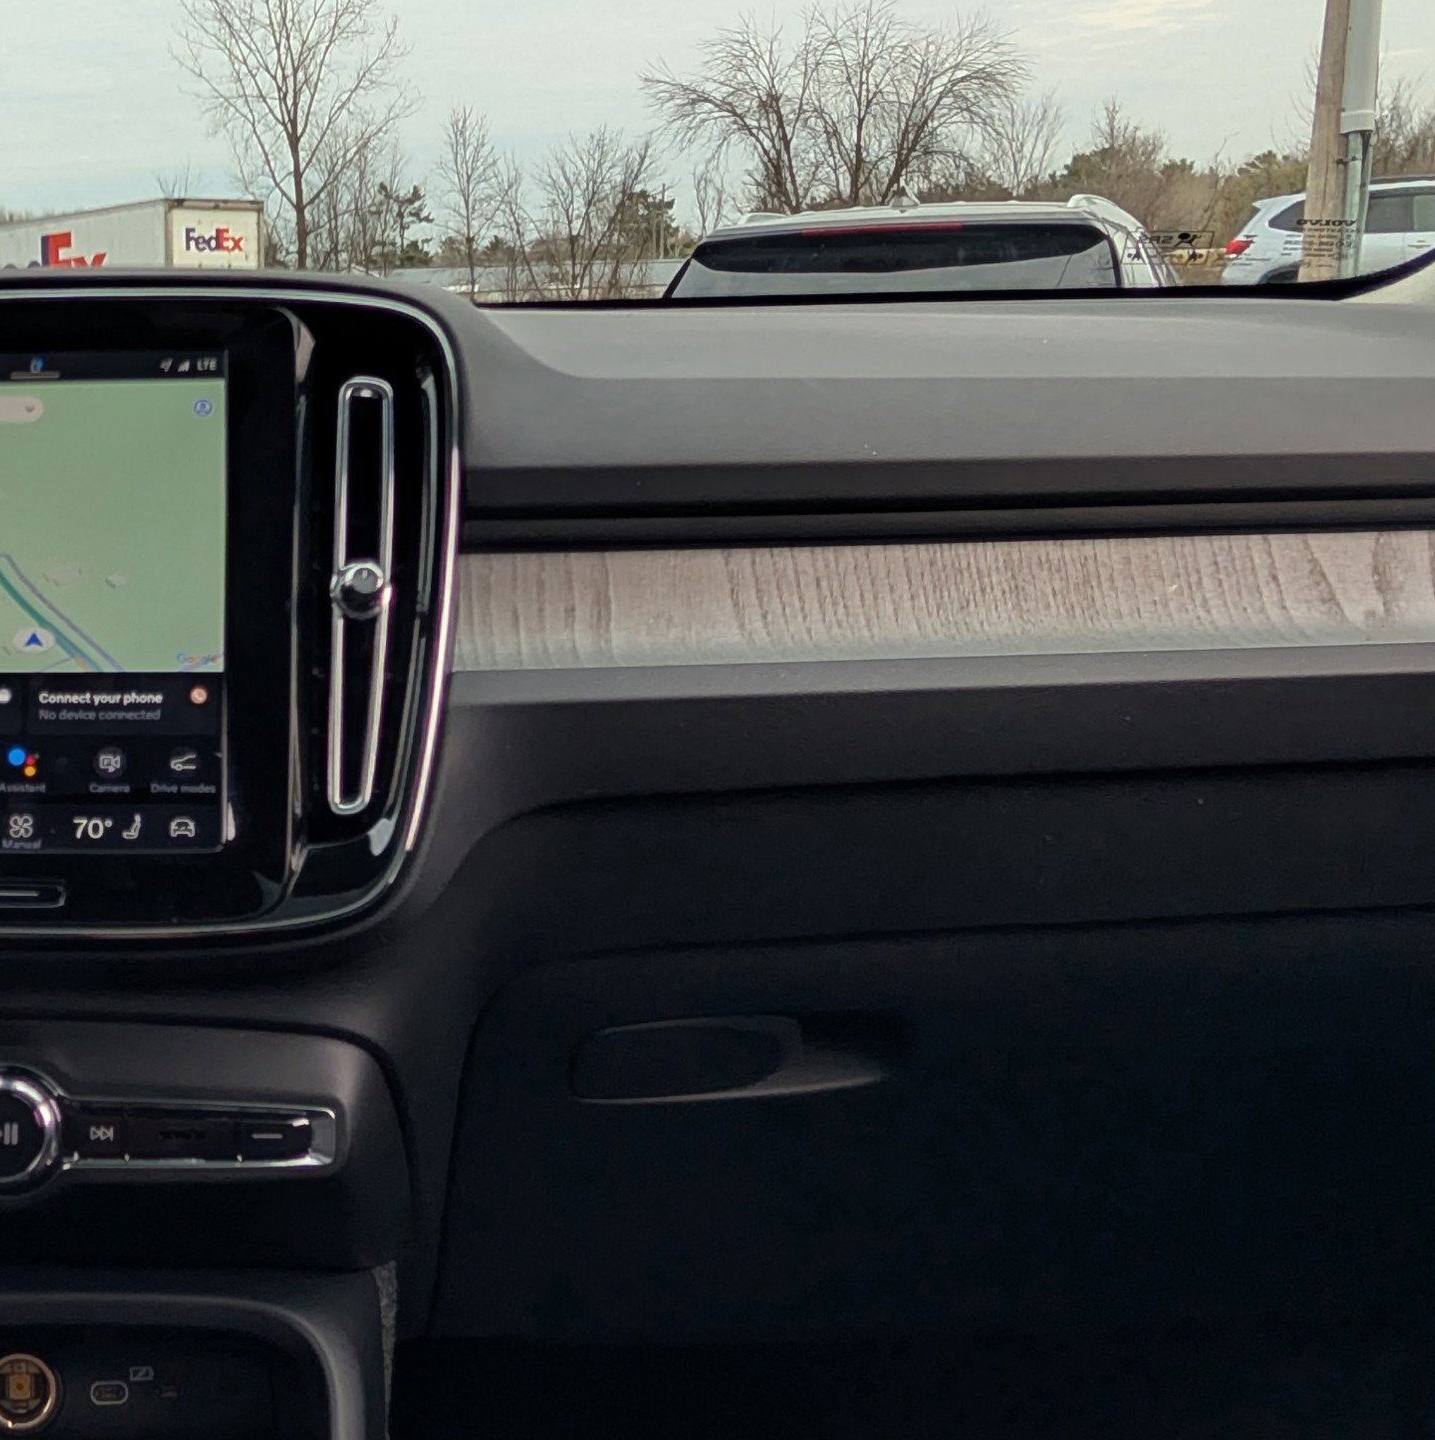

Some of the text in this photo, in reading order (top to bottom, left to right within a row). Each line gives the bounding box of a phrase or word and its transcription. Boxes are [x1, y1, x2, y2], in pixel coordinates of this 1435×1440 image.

[185, 227, 244, 252] FedEx
[197, 358, 218, 372] LTE
[176, 653, 219, 665] Google
[38, 692, 163, 708] Connect your phone
[38, 709, 161, 720] No device connected
[89, 783, 131, 793] Camera
[150, 783, 216, 793] Drive modes
[72, 817, 114, 839] 70°
[2, 838, 42, 850] Manual
